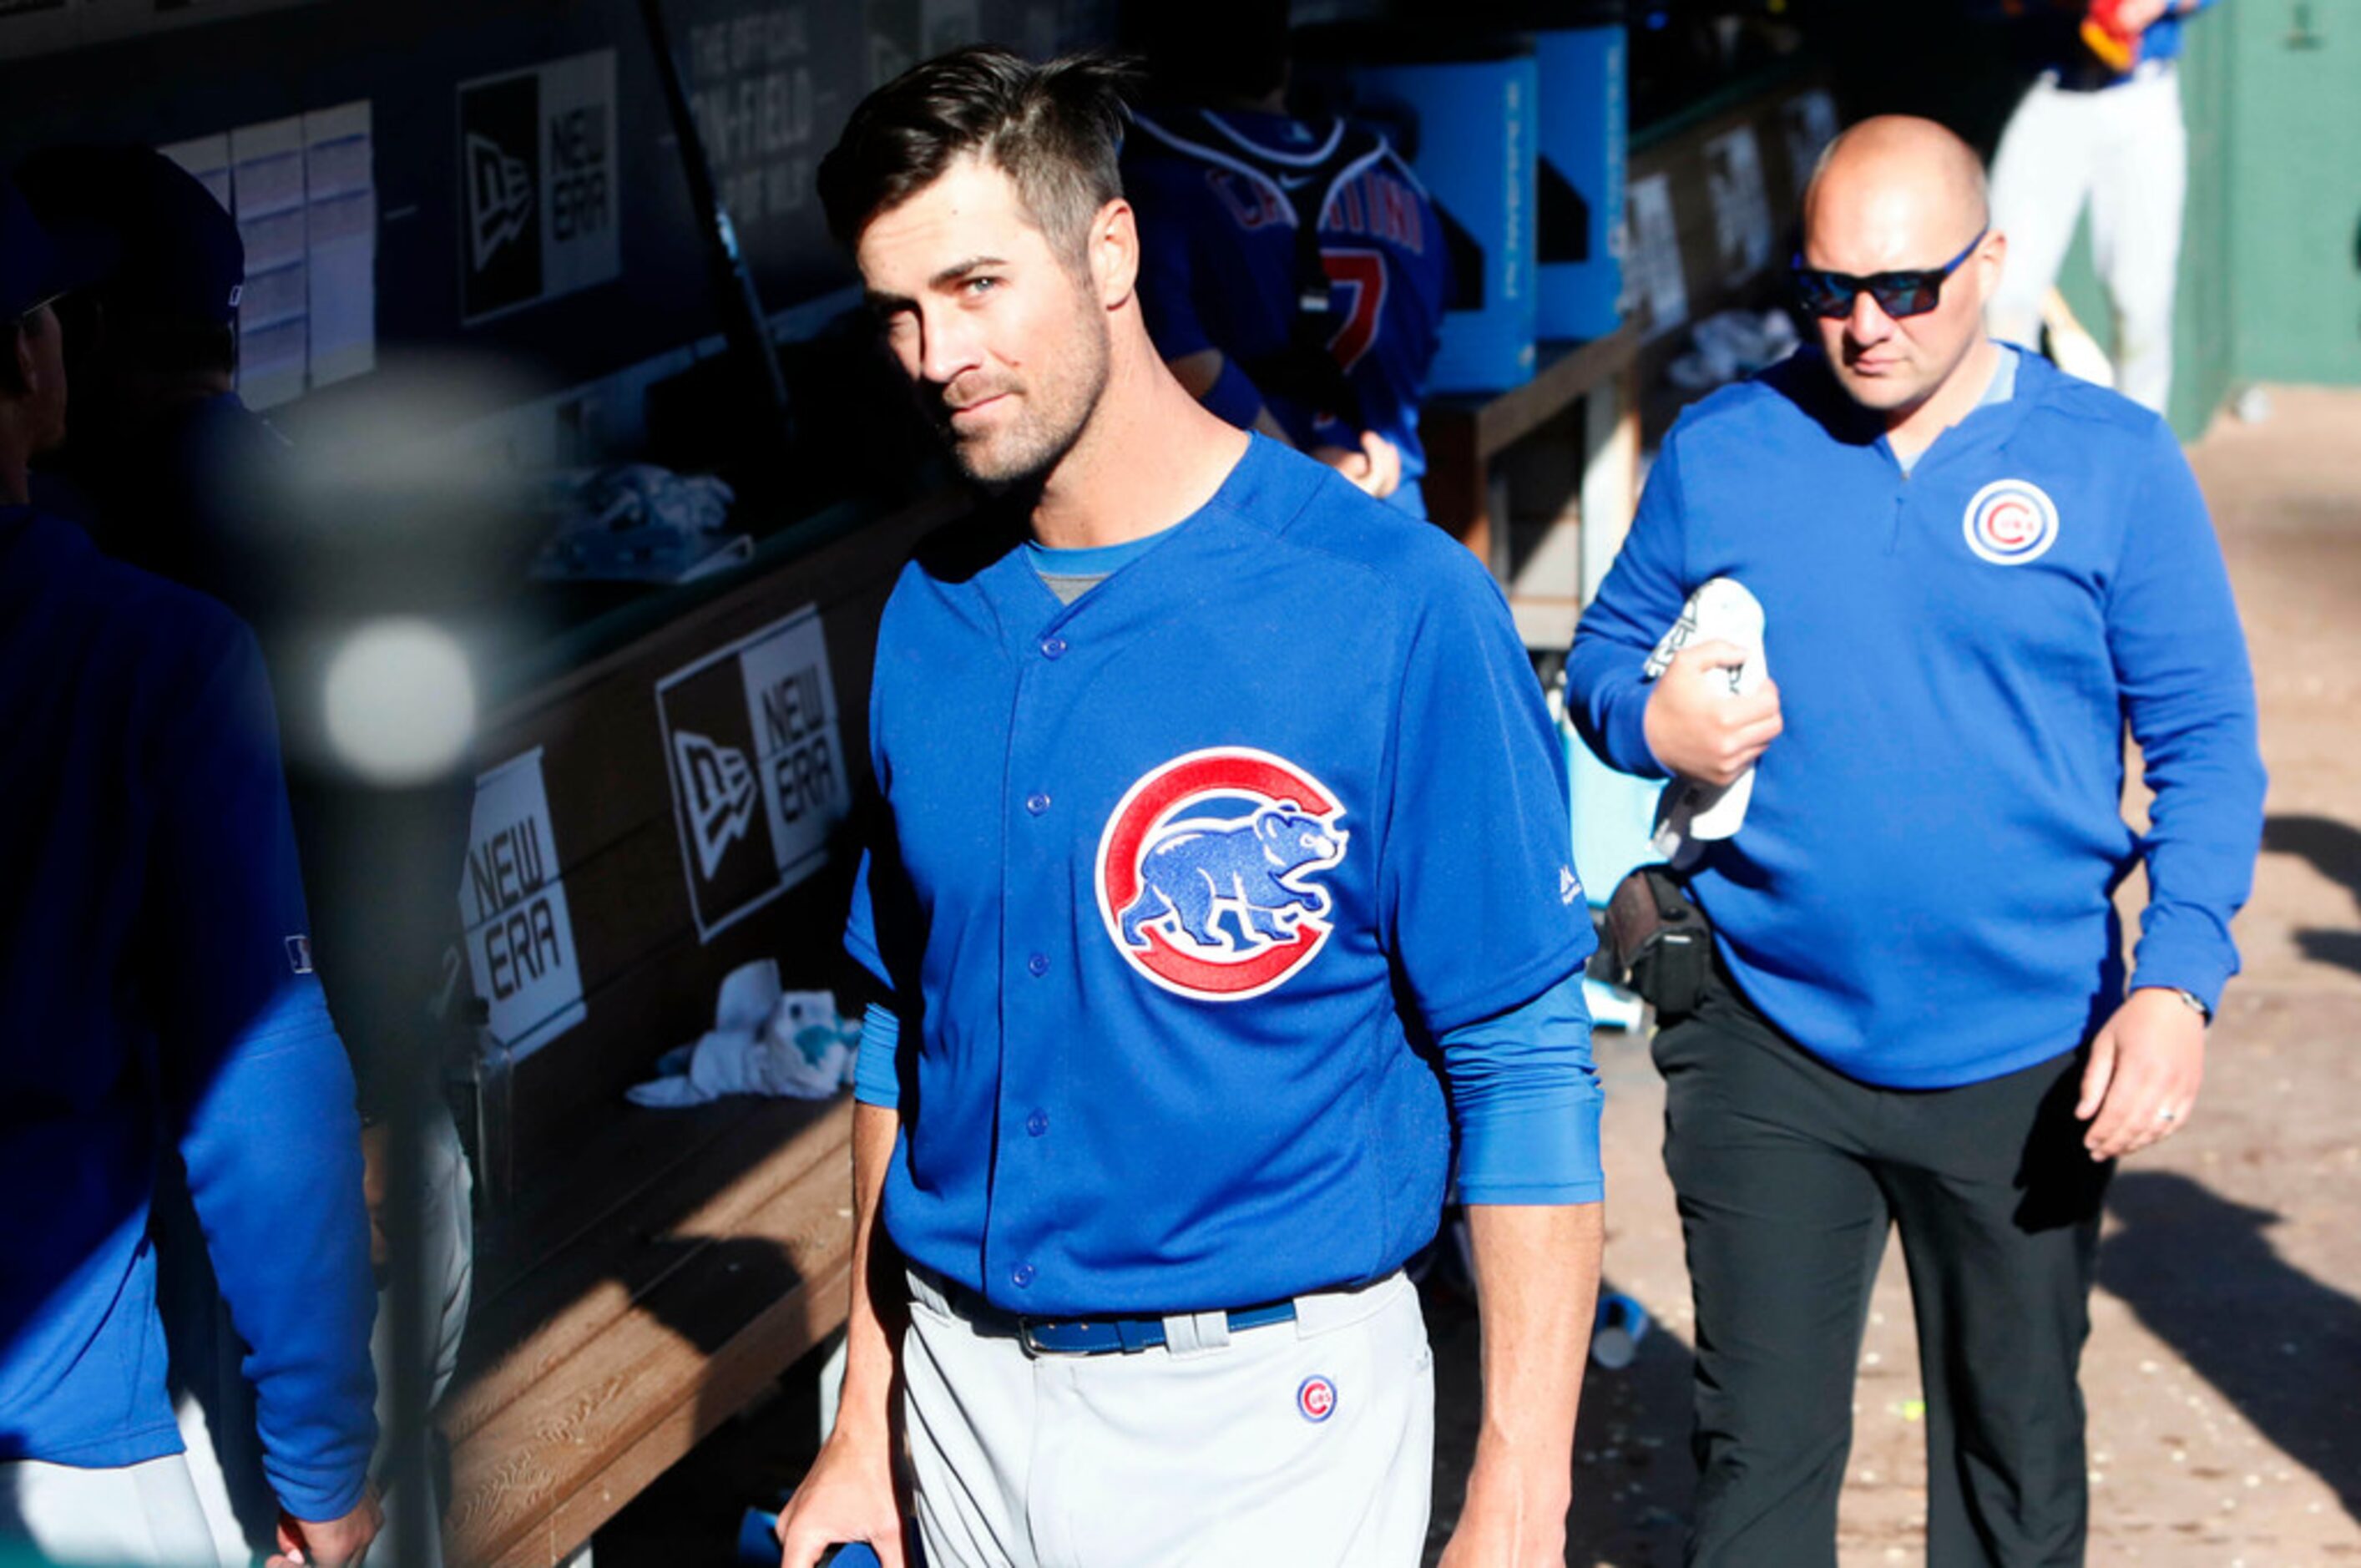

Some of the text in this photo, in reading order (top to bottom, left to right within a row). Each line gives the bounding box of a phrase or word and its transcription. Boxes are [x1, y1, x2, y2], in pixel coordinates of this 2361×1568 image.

[550, 104, 606, 183] NEW
[553, 168, 608, 242] ERA
[762, 663, 825, 755] NEW
[775, 733, 839, 823] ERA
[468, 816, 544, 923] NEW
[485, 898, 561, 1000] ERA
